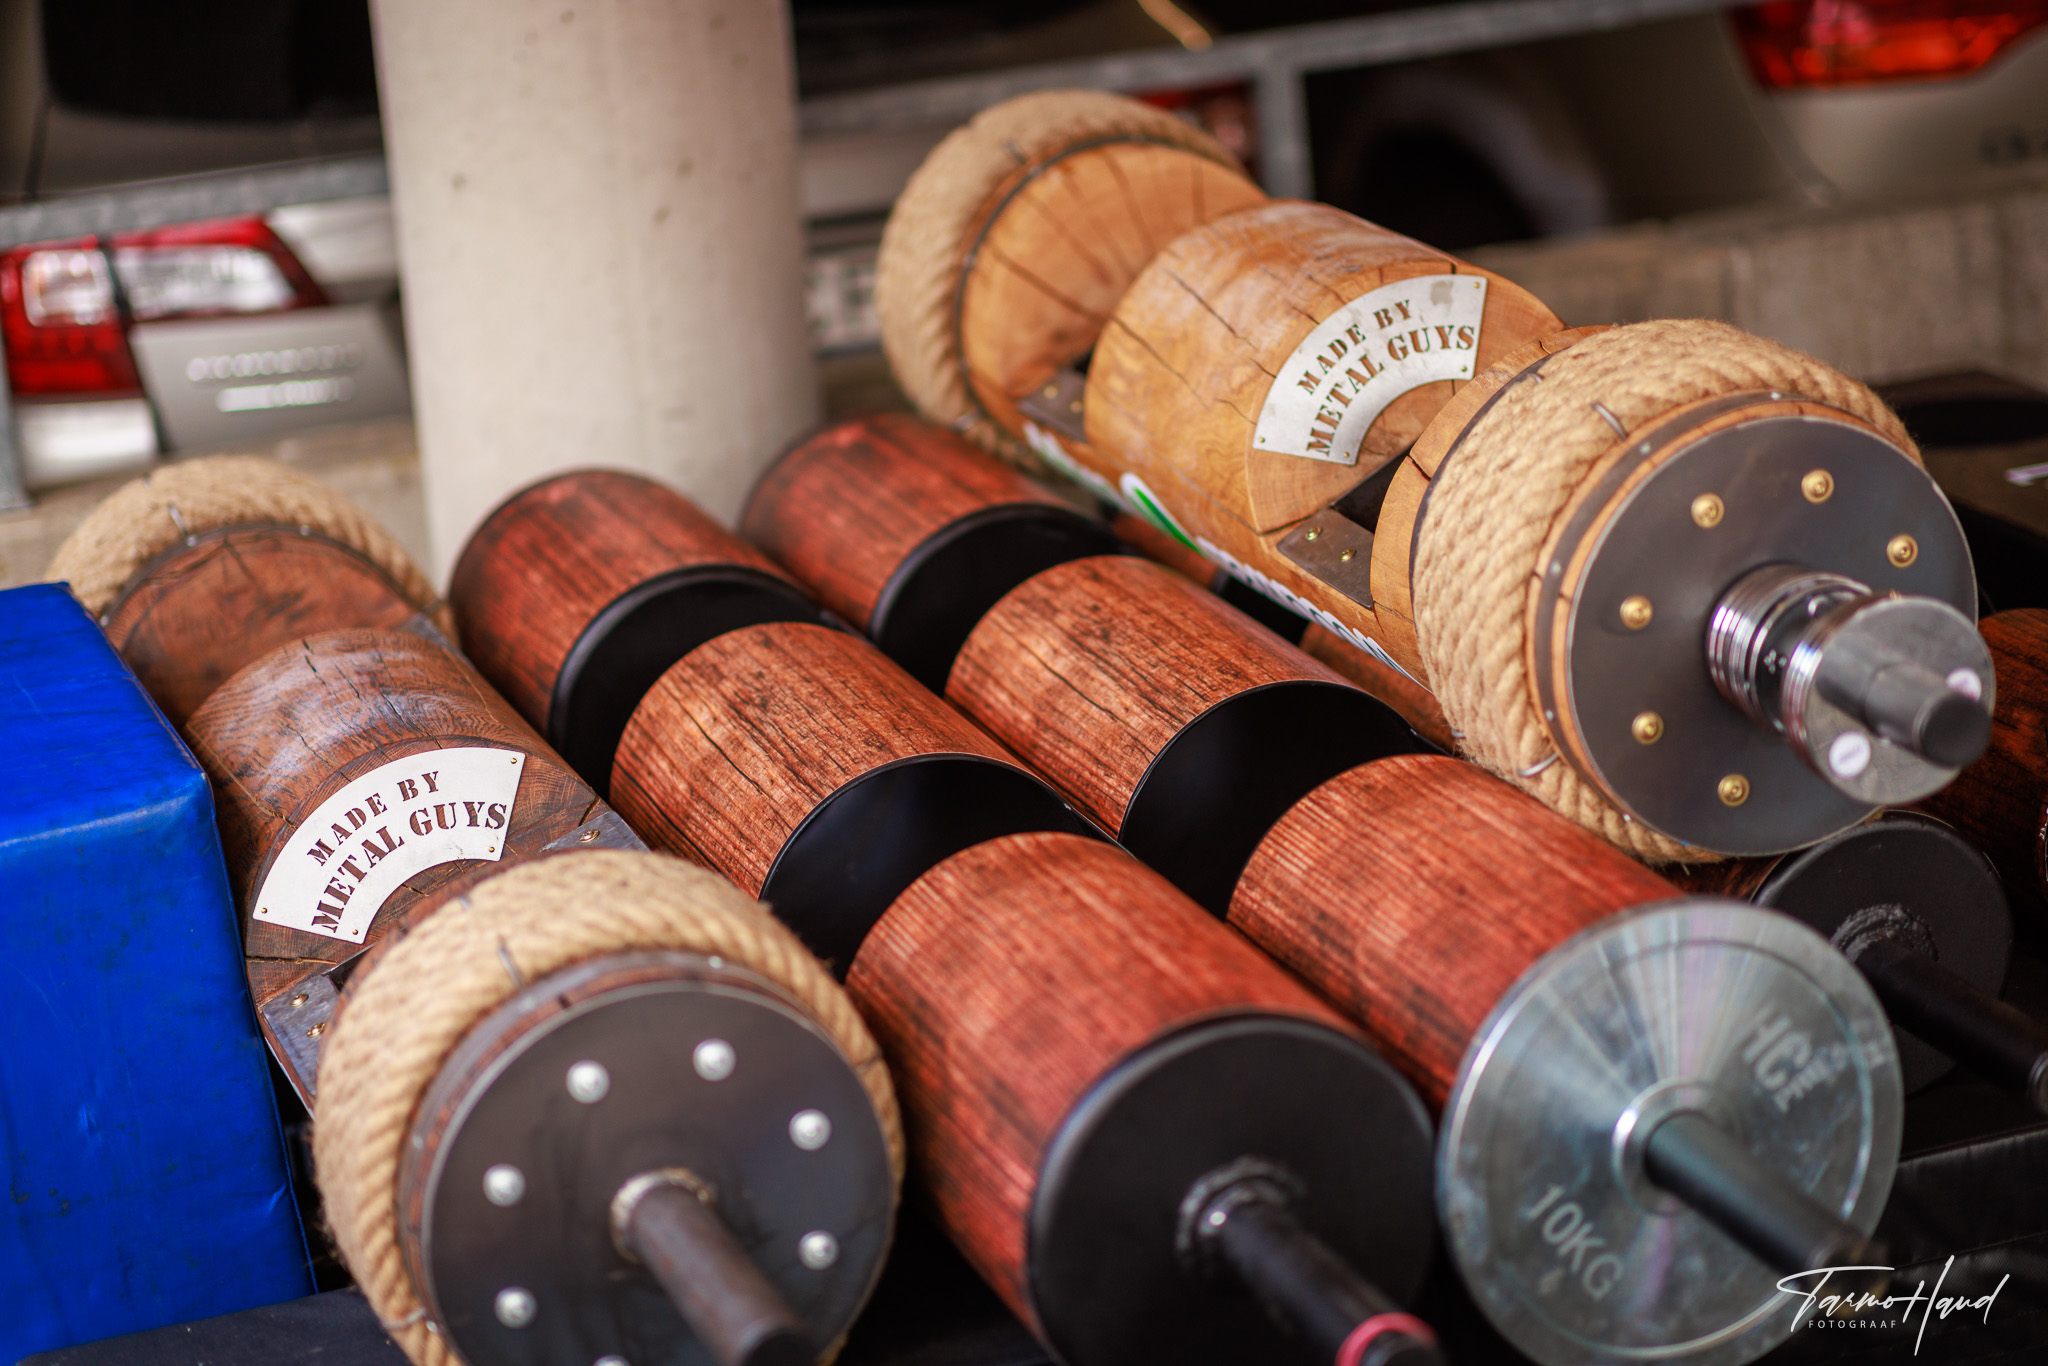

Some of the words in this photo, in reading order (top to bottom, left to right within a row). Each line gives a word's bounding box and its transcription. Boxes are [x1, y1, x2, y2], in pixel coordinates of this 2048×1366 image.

[1297, 323, 1366, 395] MADE
[1373, 300, 1411, 330] BY
[1306, 353, 1385, 457] METAL
[1387, 325, 1475, 361] GUYS
[306, 793, 388, 866] MADE
[397, 771, 439, 801] BY
[311, 825, 405, 933] METAL
[409, 801, 508, 836] GUYS
[1525, 1184, 1623, 1301] 10KG
